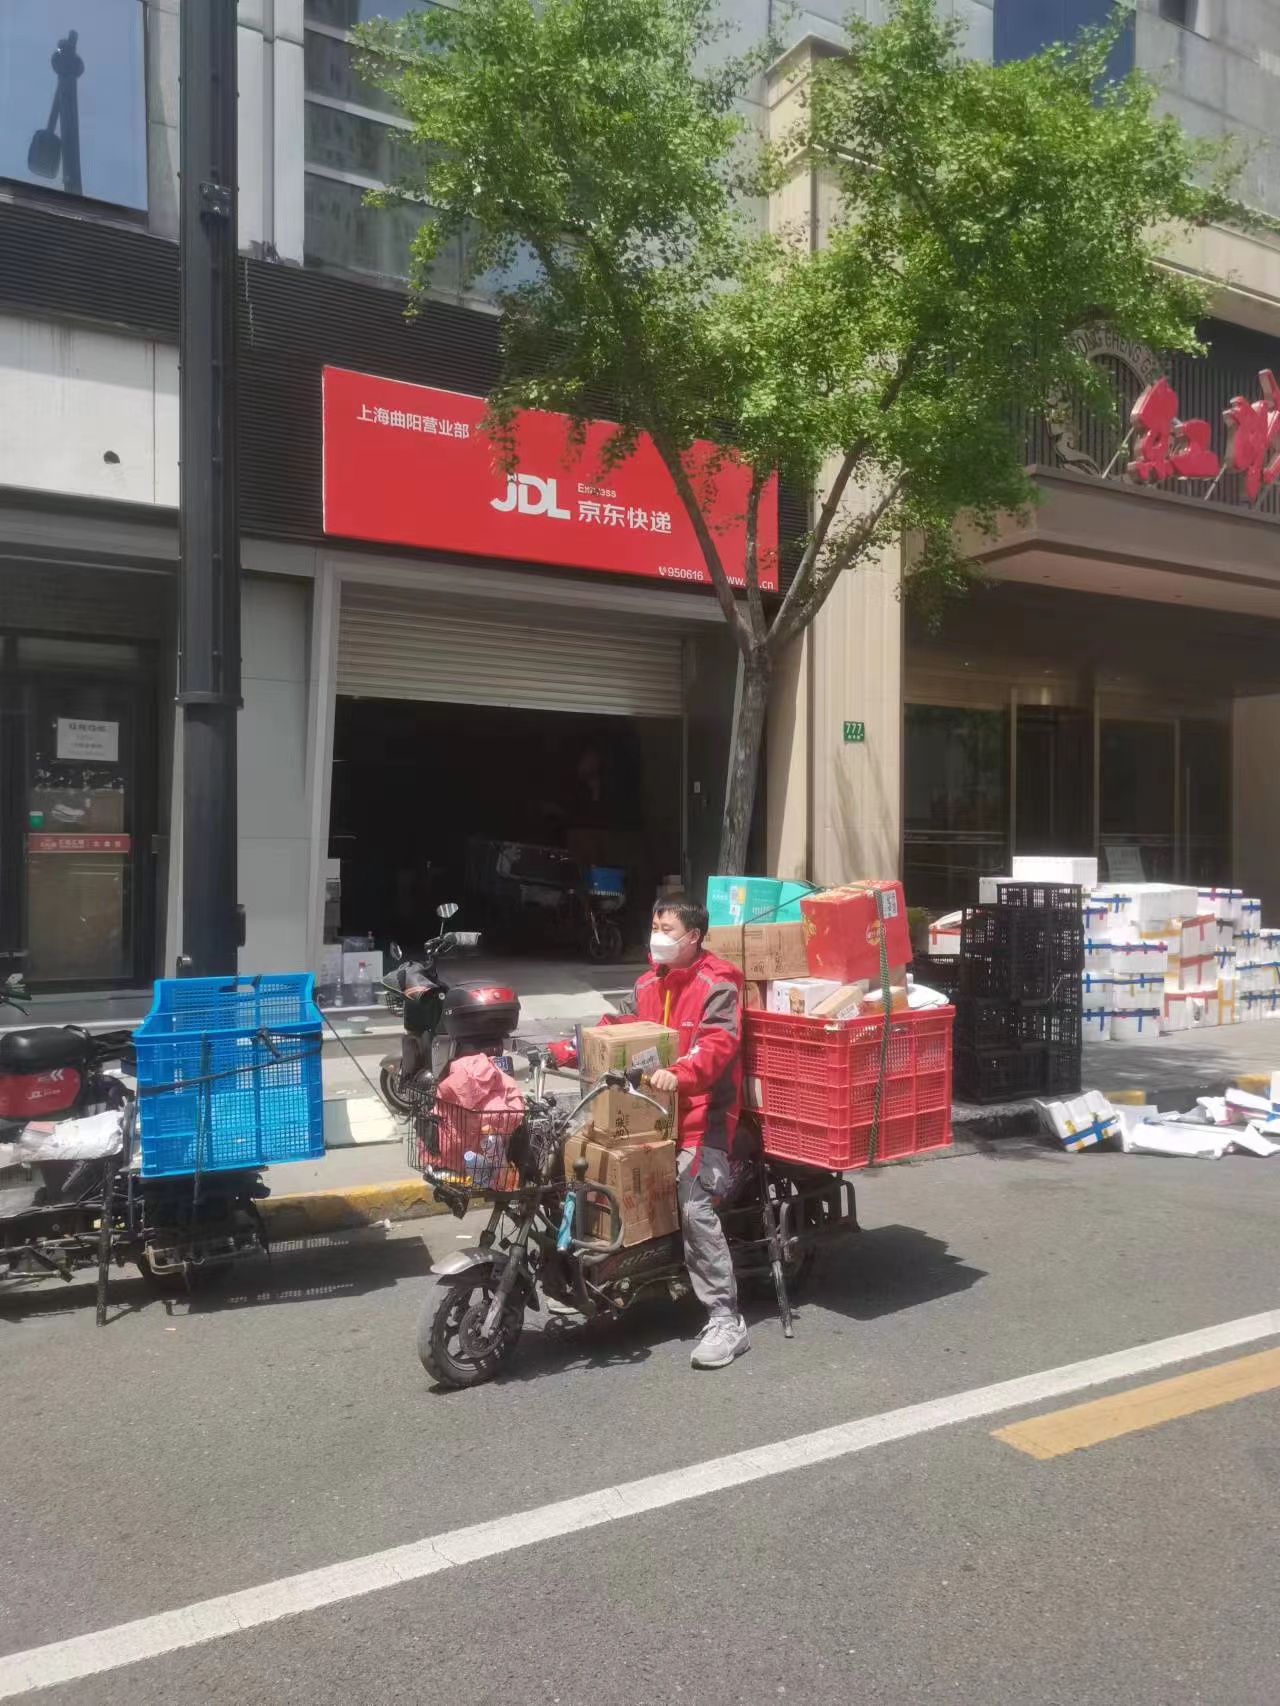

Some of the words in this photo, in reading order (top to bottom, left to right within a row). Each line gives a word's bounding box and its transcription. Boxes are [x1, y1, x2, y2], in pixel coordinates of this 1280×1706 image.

[356, 403, 470, 439] 上海曲阳营业部
[490, 472, 571, 520] JDL
[578, 500, 672, 534] 京东快递
[667, 567, 704, 581] 950616
